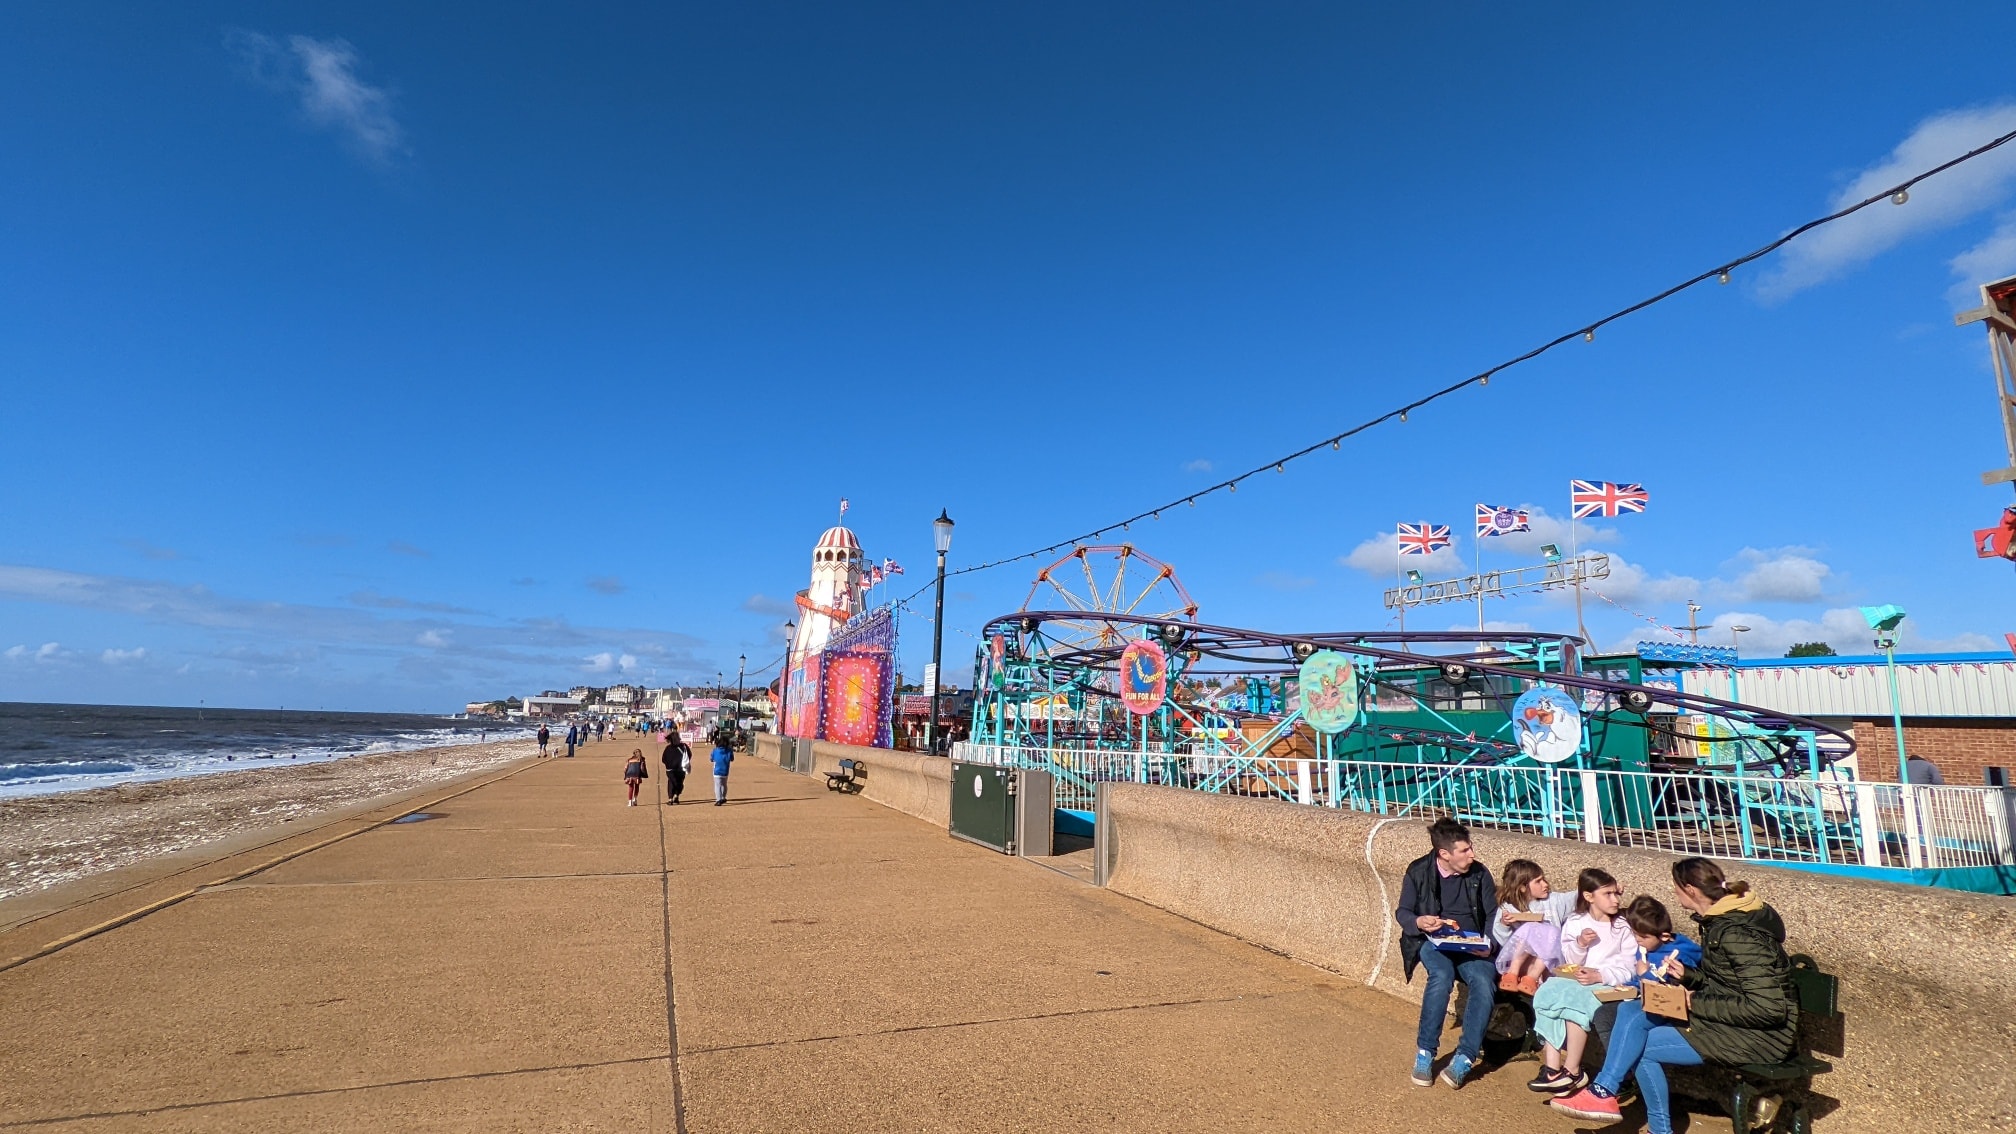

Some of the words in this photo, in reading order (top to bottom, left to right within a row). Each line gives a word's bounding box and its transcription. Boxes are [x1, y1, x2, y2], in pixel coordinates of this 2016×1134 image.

[1126, 692, 1136, 700] FUN
[1138, 692, 1149, 700] FOR
[1150, 693, 1160, 701] ALL
